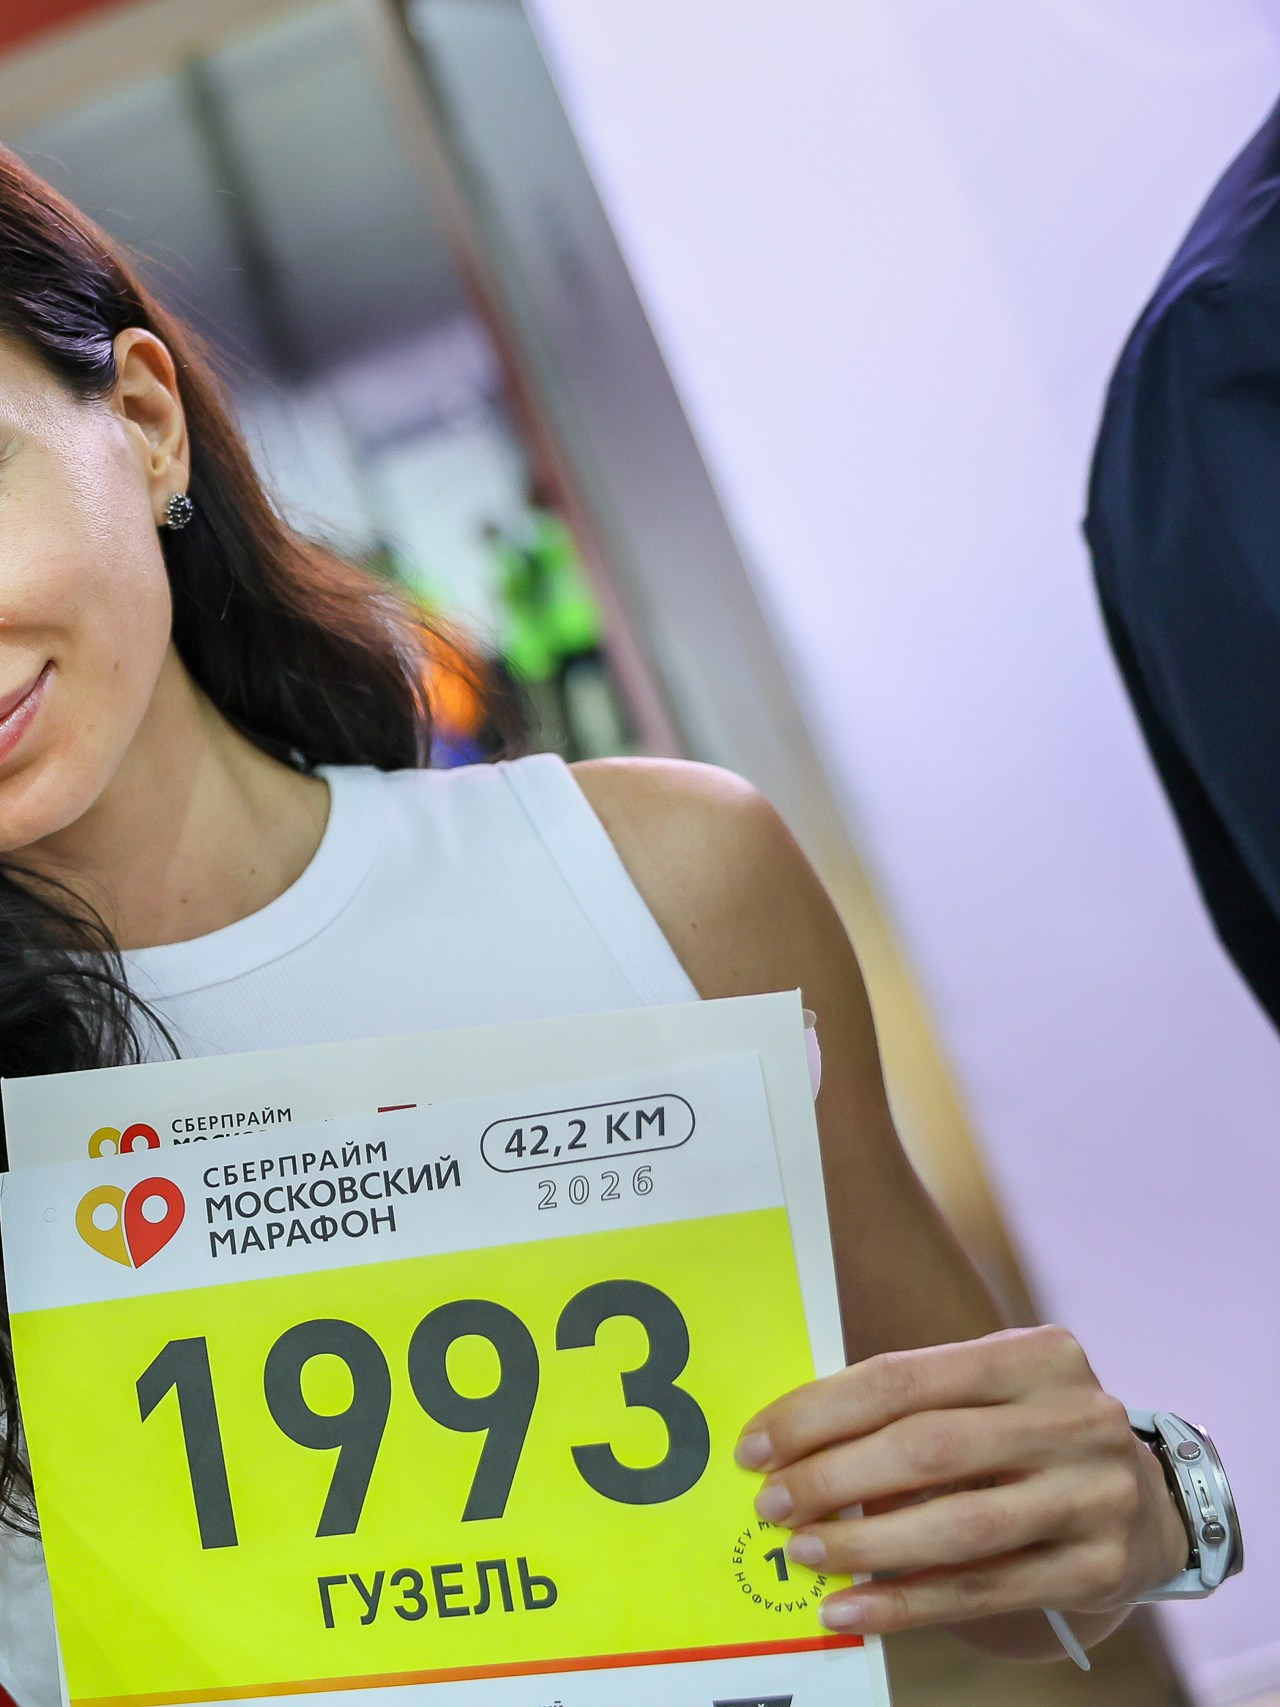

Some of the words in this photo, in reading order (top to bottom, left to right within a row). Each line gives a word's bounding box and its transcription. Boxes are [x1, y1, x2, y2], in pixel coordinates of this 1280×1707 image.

[171, 1107, 292, 1134] СБЕРПРАЙМ
[504, 1119, 587, 1158] 42,2
[606, 1106, 665, 1145] КМ
[202, 1140, 388, 1189] СБЕРПРАЙМ
[537, 1165, 654, 1211] 2026
[205, 1155, 461, 1224] МОСКОВСКИЙ
[209, 1204, 397, 1258] МАРАФОН
[135, 1279, 711, 1551] 1993
[732, 1527, 752, 1564] БЕГУ
[763, 1547, 789, 1582] 1
[317, 1557, 558, 1629] ГУЗЕЛЬ
[734, 1571, 808, 1612] МАРАФОН
